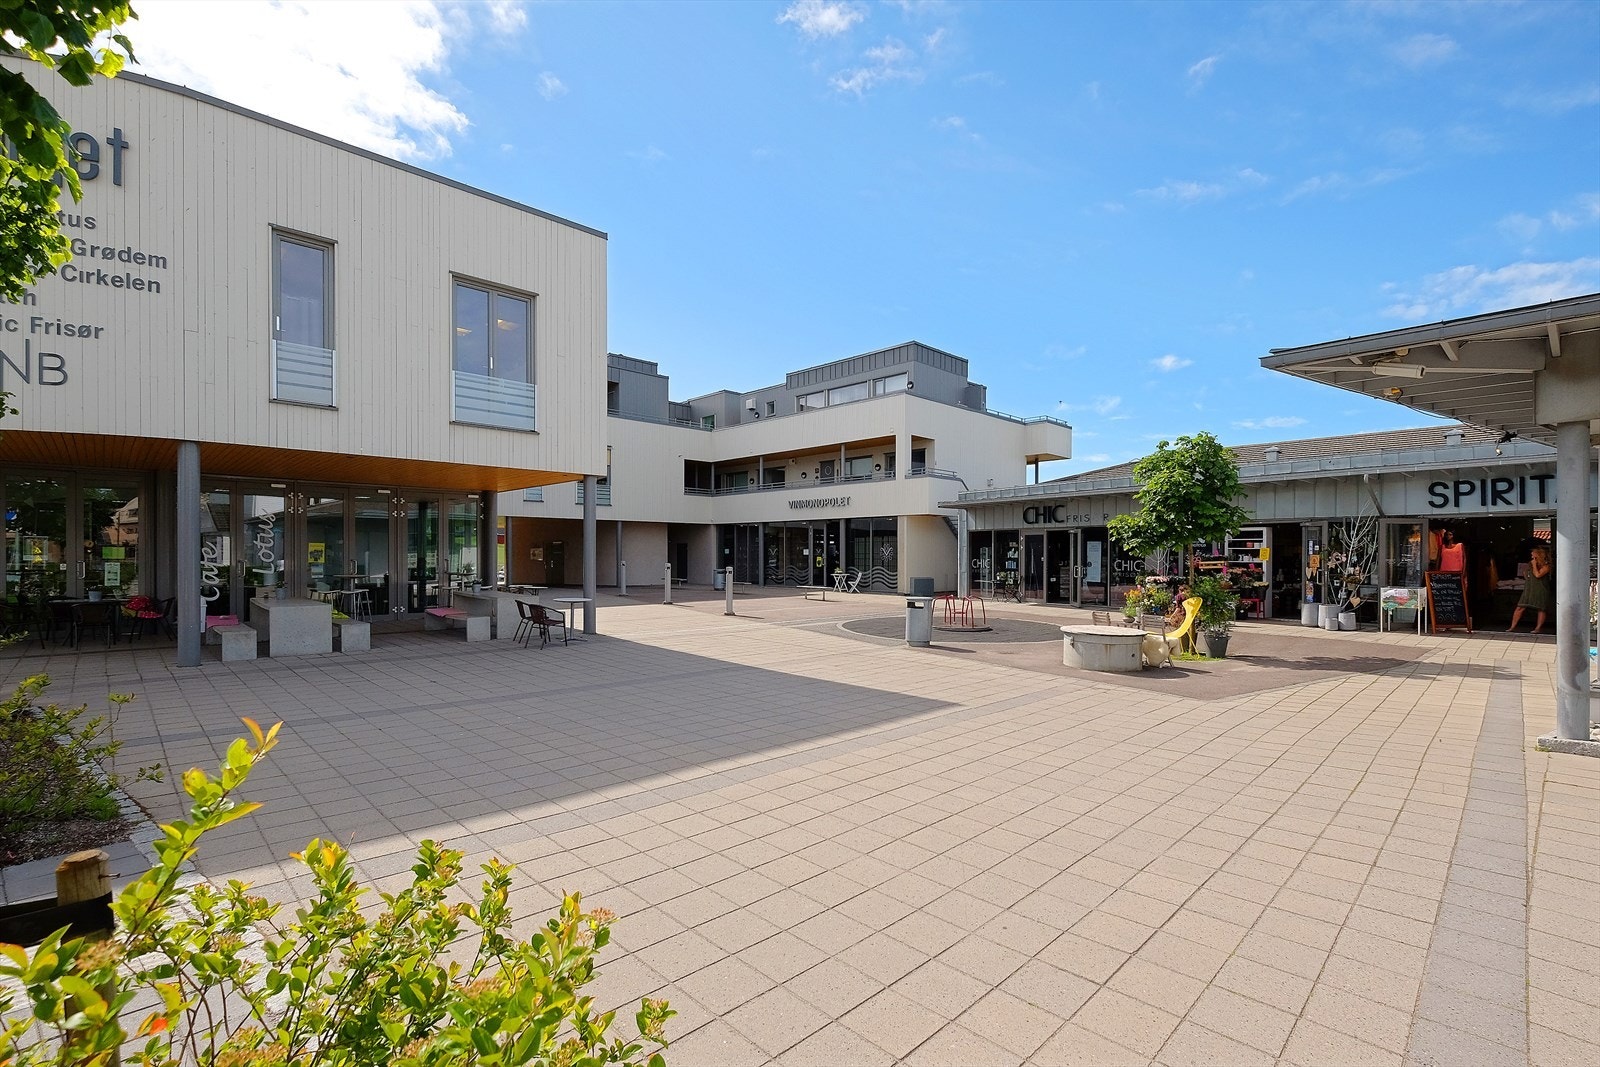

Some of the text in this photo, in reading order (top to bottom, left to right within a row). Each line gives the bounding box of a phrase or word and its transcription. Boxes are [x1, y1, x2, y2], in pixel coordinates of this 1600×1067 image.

[71, 237, 167, 269] Grødem
[30, 316, 104, 339] Frisør
[1428, 474, 1557, 509] SPIRIT
[788, 496, 851, 509] VINMONOPOLET
[1023, 505, 1065, 524] CHIC
[252, 508, 276, 574] Lotus
[971, 558, 990, 568] CHIC
[1114, 559, 1141, 571] CHIC
